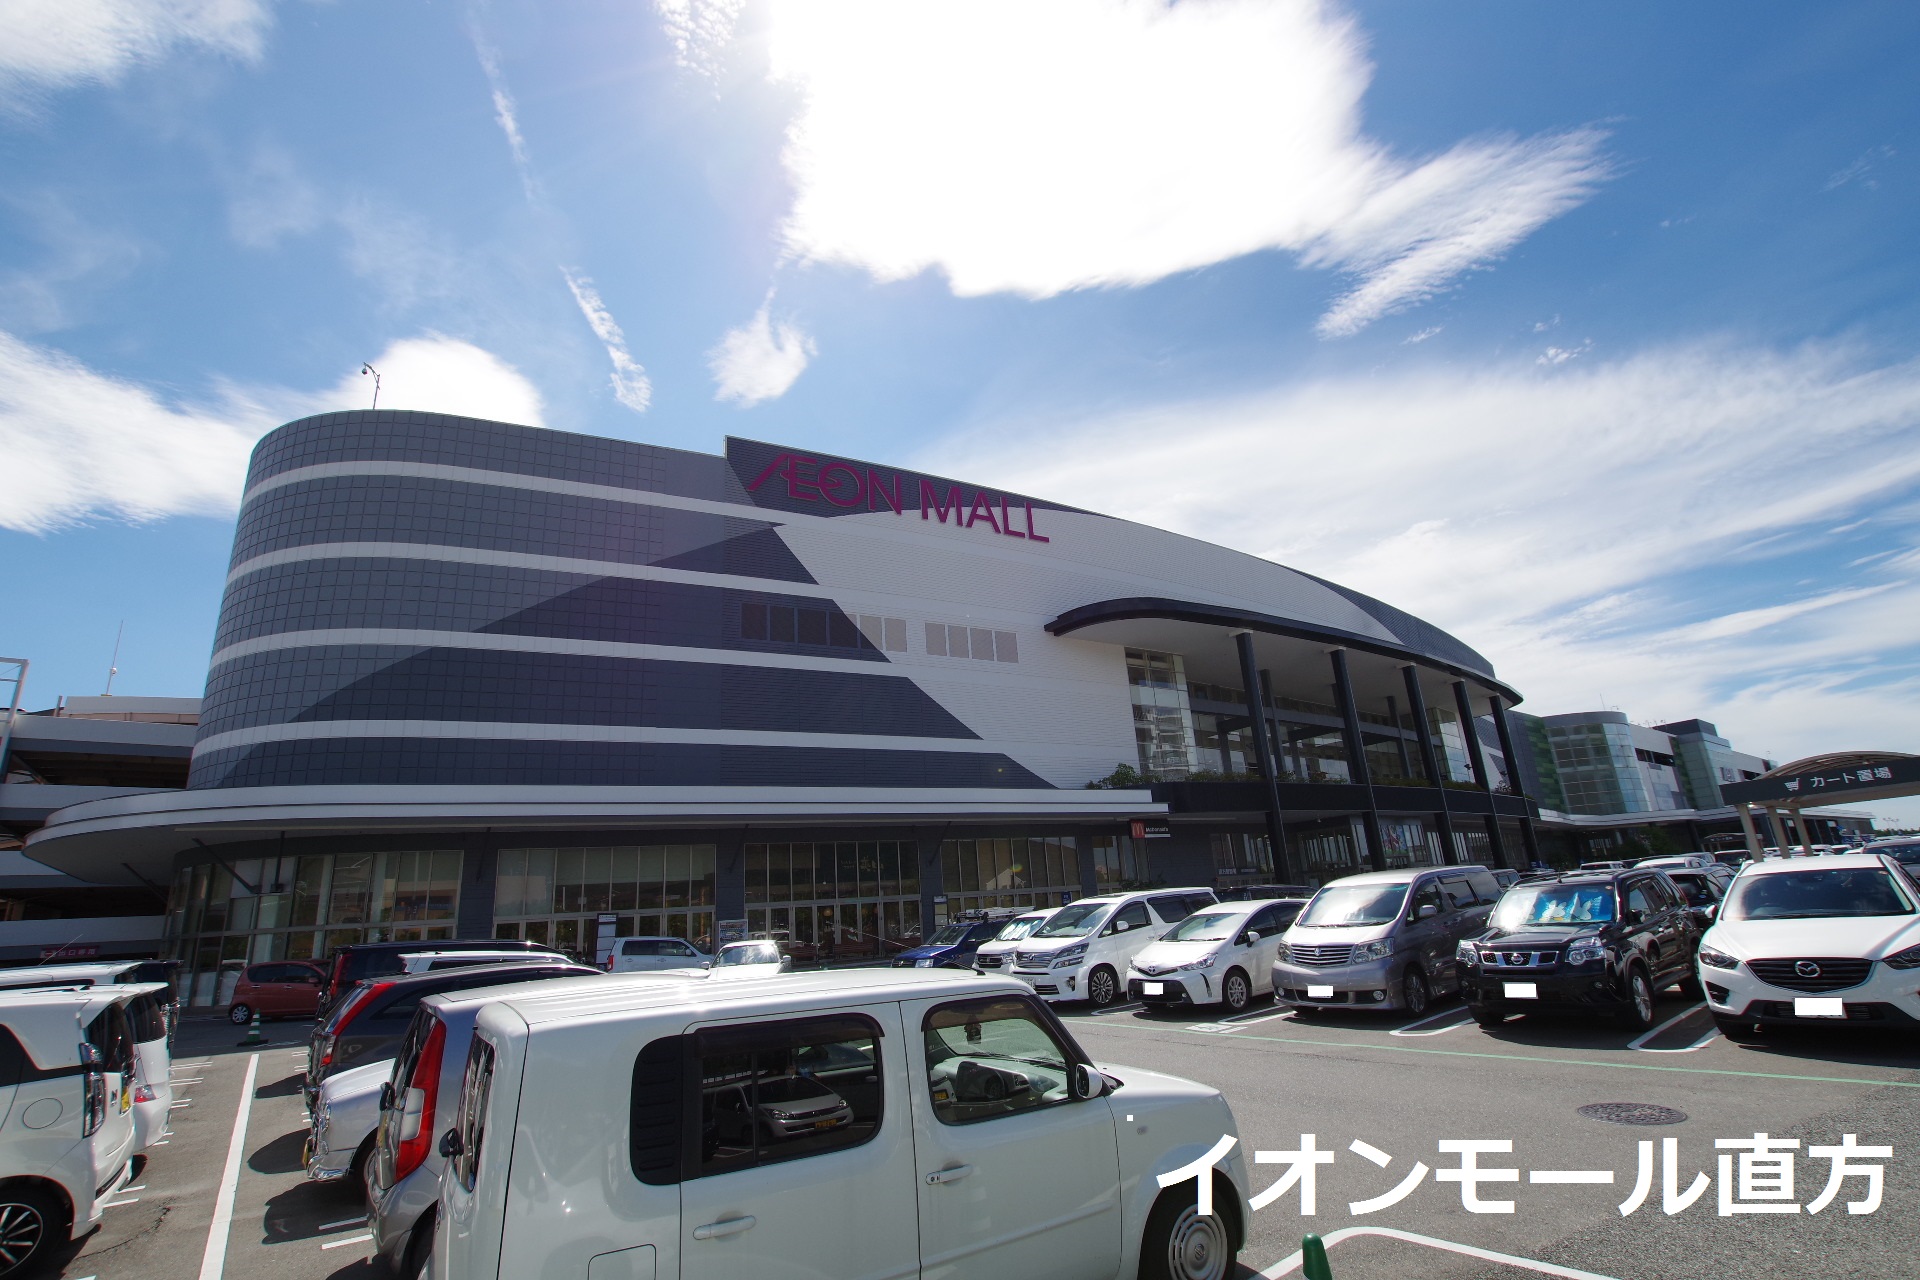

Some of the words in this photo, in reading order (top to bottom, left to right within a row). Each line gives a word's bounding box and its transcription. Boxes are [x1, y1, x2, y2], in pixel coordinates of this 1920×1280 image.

[918, 479, 1050, 543] MALL
[1810, 766, 1892, 788] カート置場
